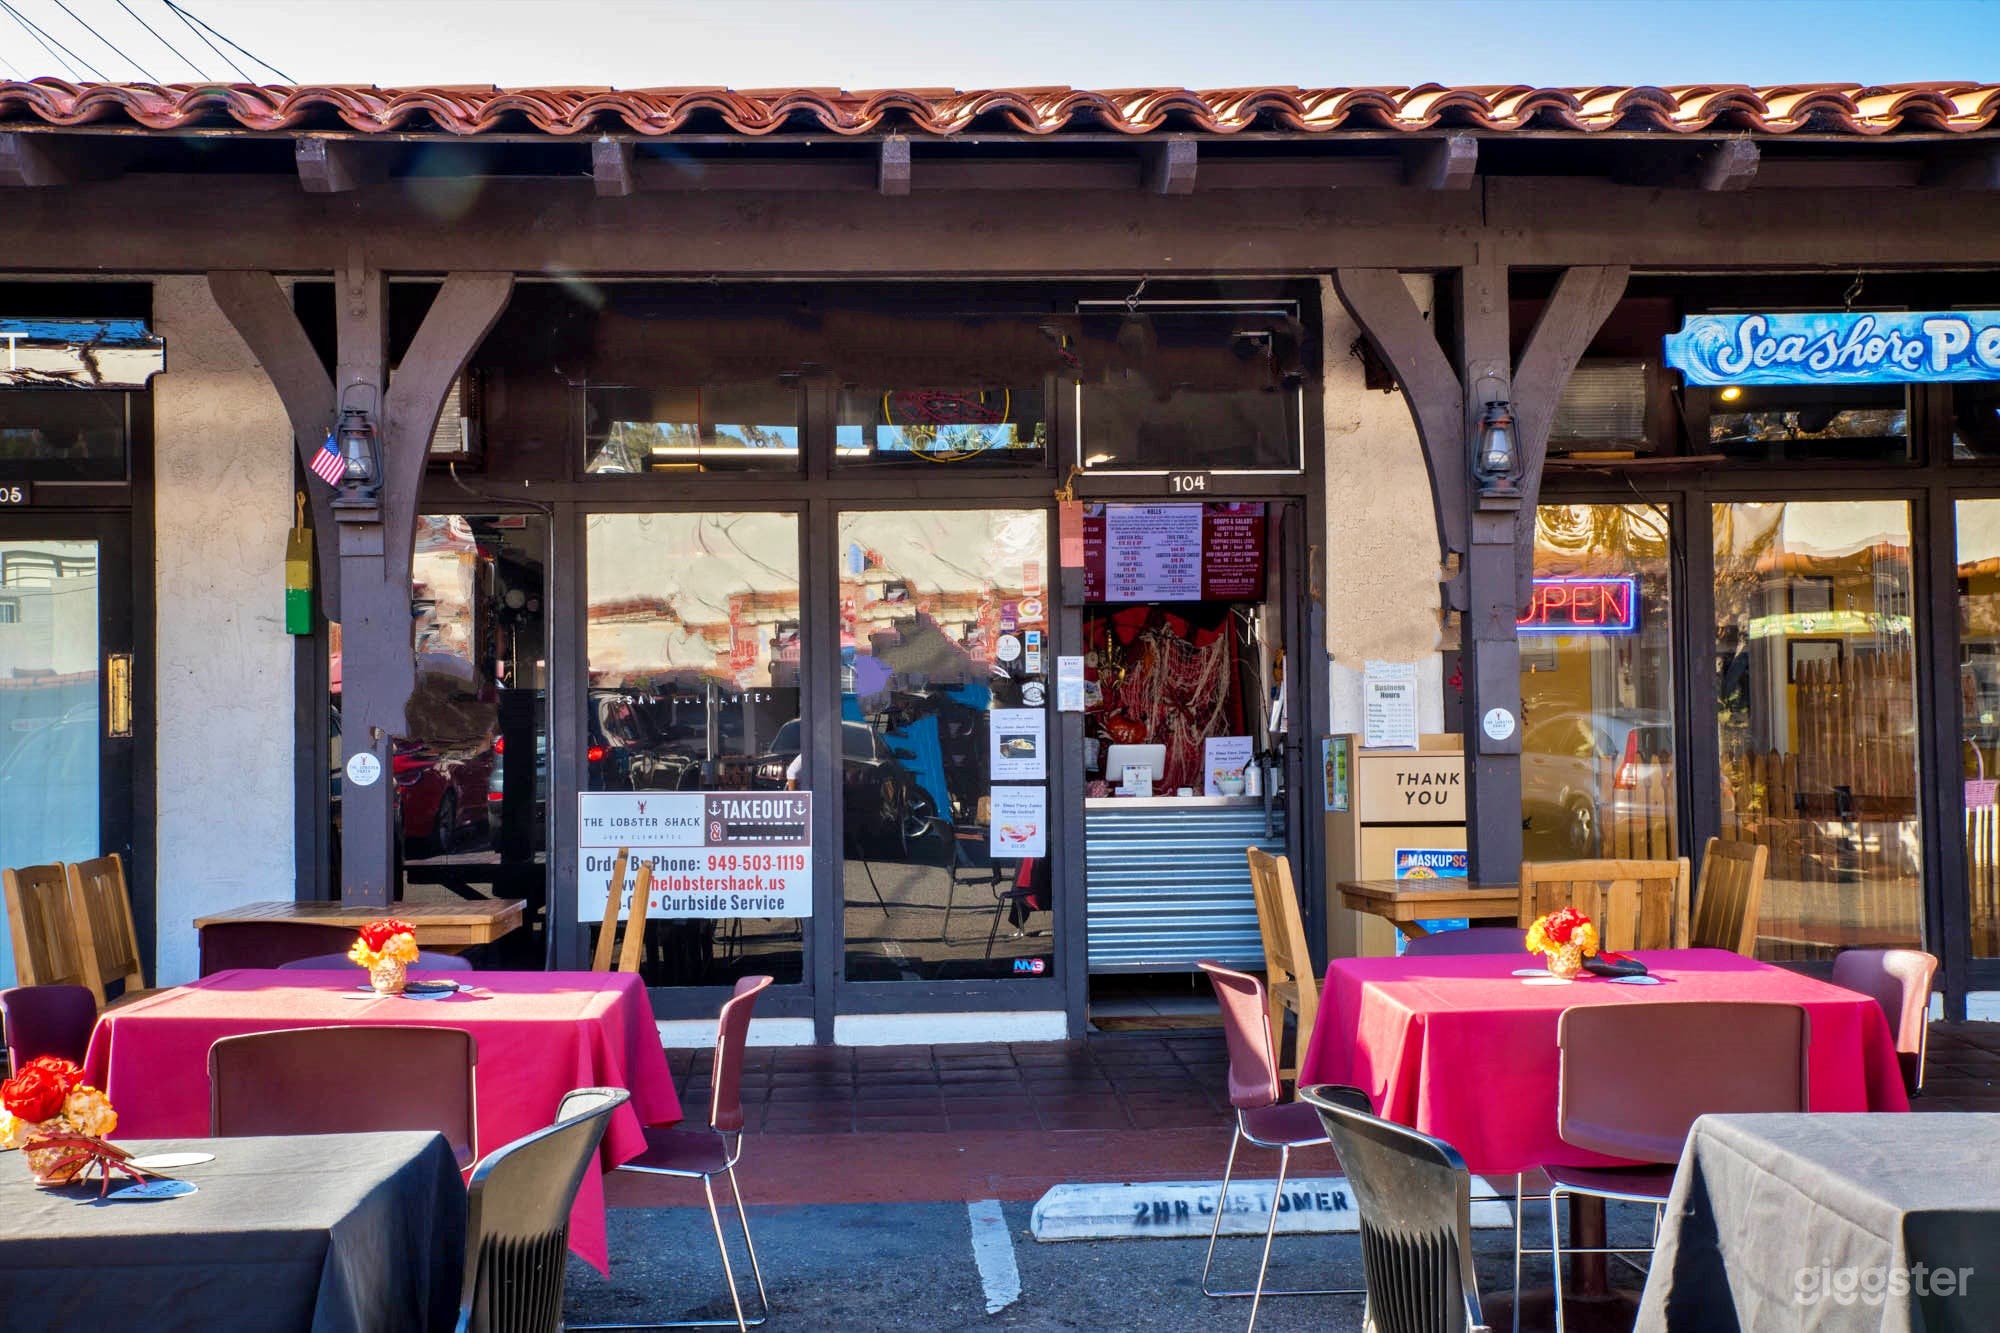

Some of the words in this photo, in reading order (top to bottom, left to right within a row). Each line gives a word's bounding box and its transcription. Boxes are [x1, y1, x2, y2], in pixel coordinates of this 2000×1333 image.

[1716, 314, 1923, 373] Seashore
[1173, 475, 1205, 492] 104
[1396, 773, 1460, 786] THANK
[1405, 790, 1448, 805] YOU
[721, 800, 793, 819] TAKEOUT
[584, 817, 604, 827] THE
[610, 817, 658, 827] LOBSTER
[664, 817, 701, 827] SHACK
[586, 856, 618, 872] Ord
[651, 856, 701, 872] Phone:
[707, 855, 805, 871] 949-503-1119
[662, 894, 727, 911] Curbside
[731, 894, 785, 911] Service
[1134, 1199, 1189, 1226] 2HR
